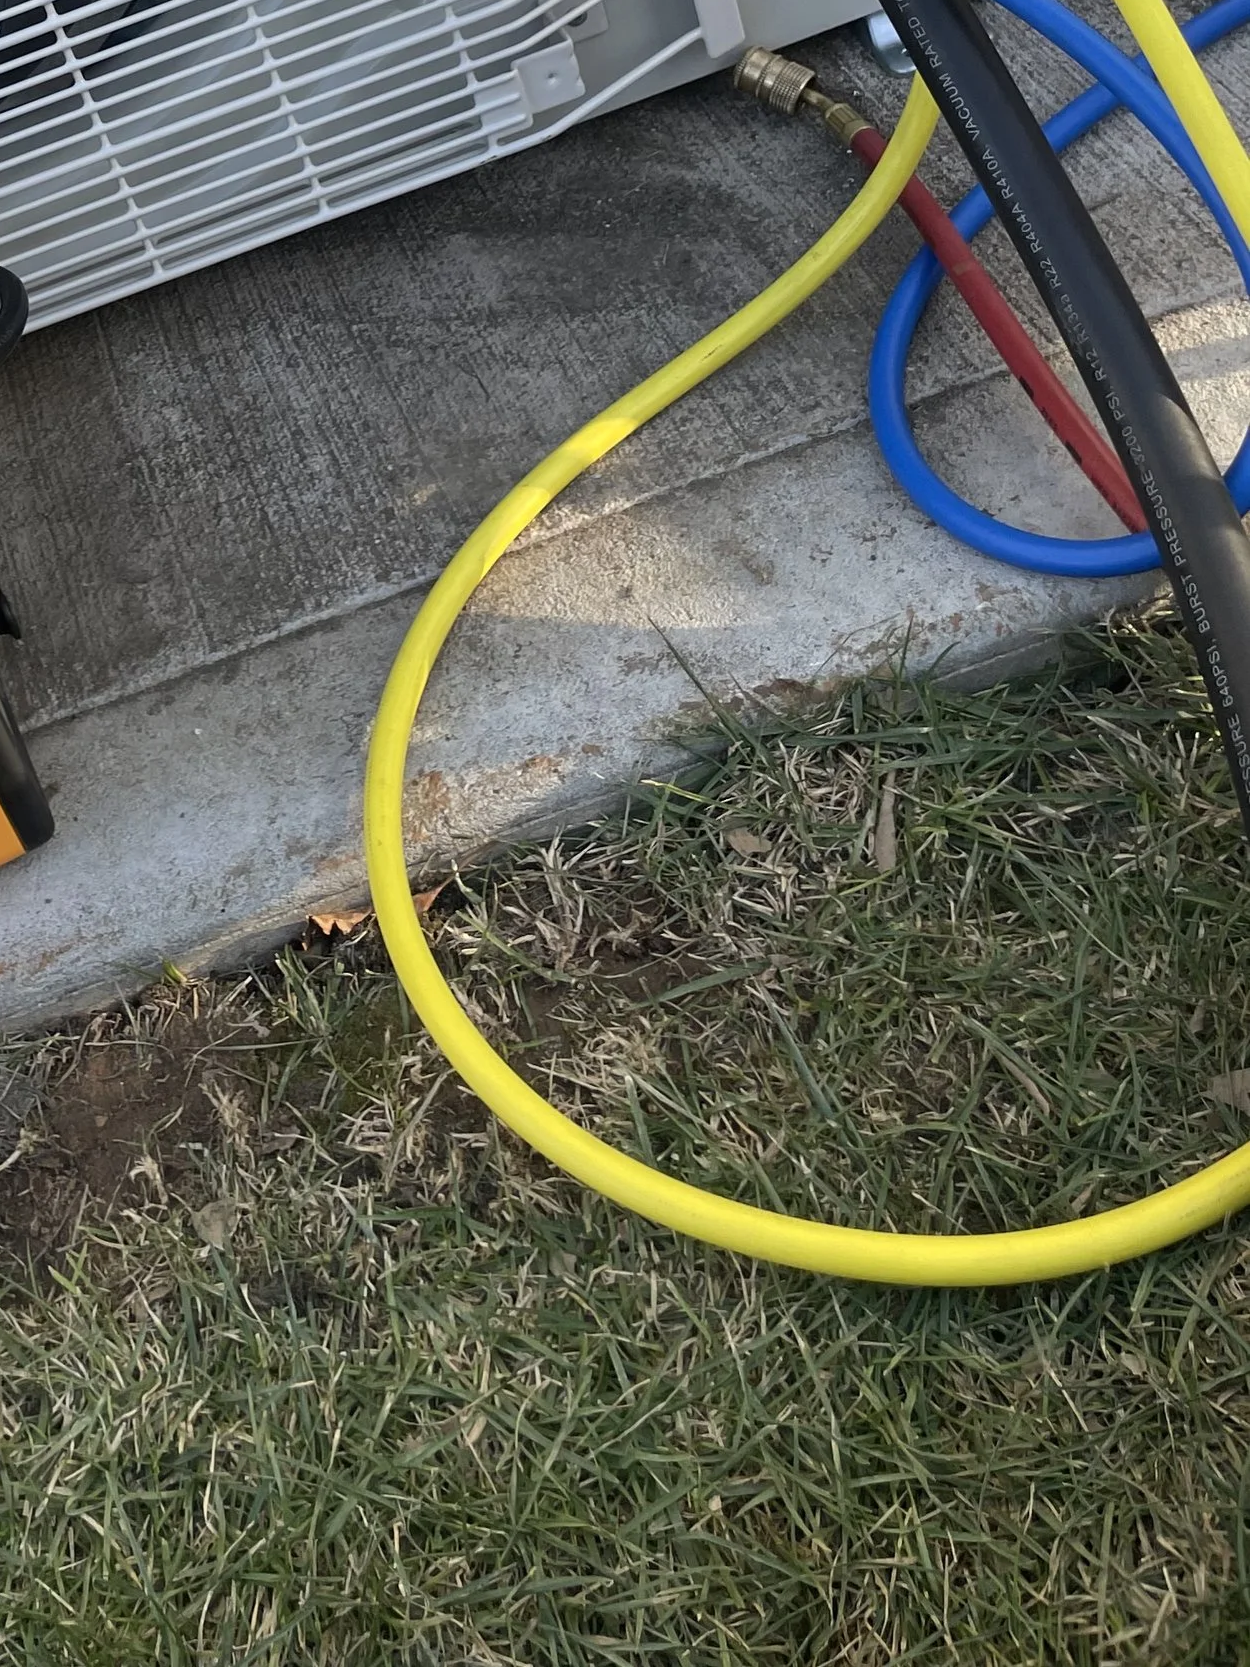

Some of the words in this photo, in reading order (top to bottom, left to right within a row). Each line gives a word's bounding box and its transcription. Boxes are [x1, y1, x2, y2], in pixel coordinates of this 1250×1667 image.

[908, 16, 943, 70] RATED
[938, 72, 981, 142] VACUUM
[1011, 202, 1043, 255] R404A
[1039, 256, 1062, 289] R22
[1060, 293, 1090, 343] R134a
[1086, 347, 1107, 382] R12
[1121, 425, 1146, 466] 3200
[1141, 468, 1187, 568] PRESSURE
[1180, 574, 1211, 634] BURST
[1206, 638, 1234, 708] 640PSI,
